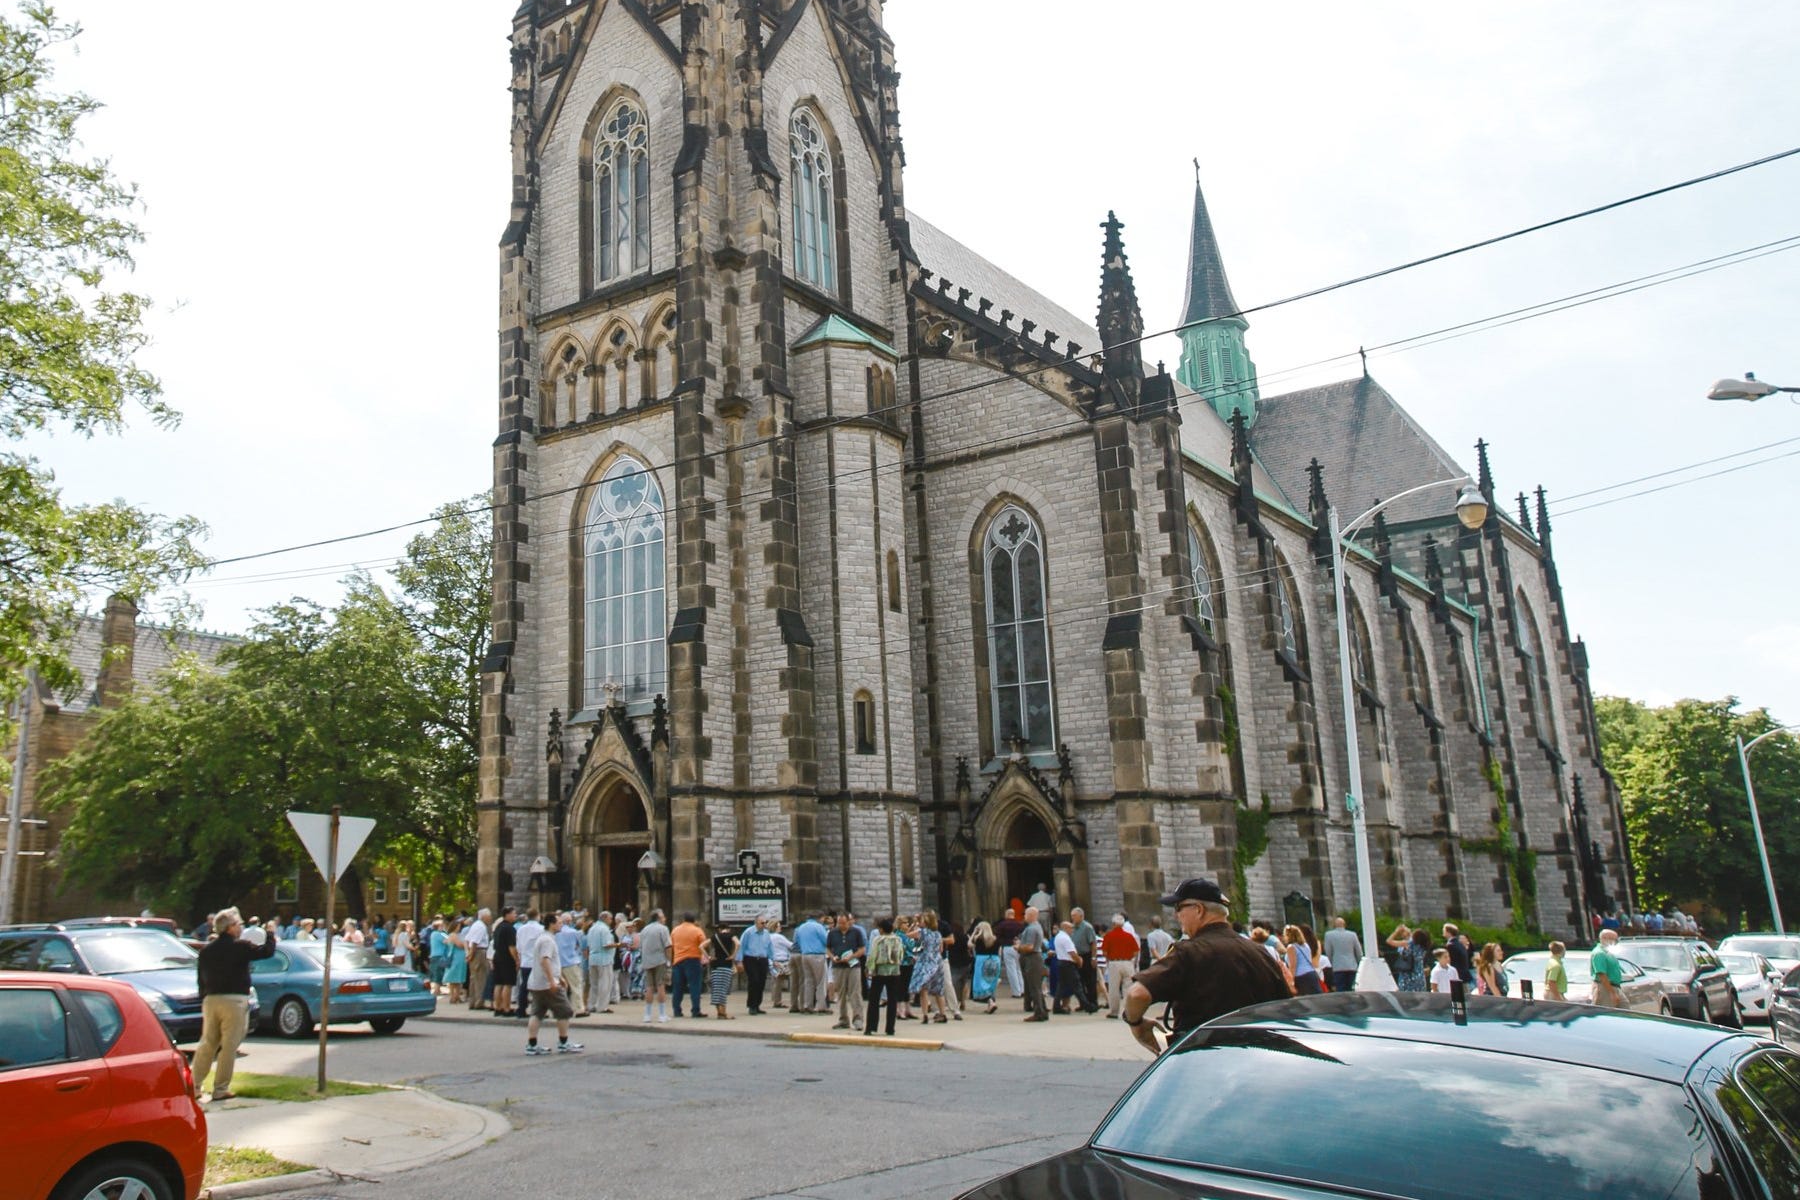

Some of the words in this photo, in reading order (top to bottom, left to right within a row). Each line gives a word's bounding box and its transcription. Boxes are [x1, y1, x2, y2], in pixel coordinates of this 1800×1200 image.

[724, 878, 746, 886] Saint
[747, 878, 775, 888] Joseph
[717, 886, 751, 894] Catholic
[752, 886, 782, 894] Church
